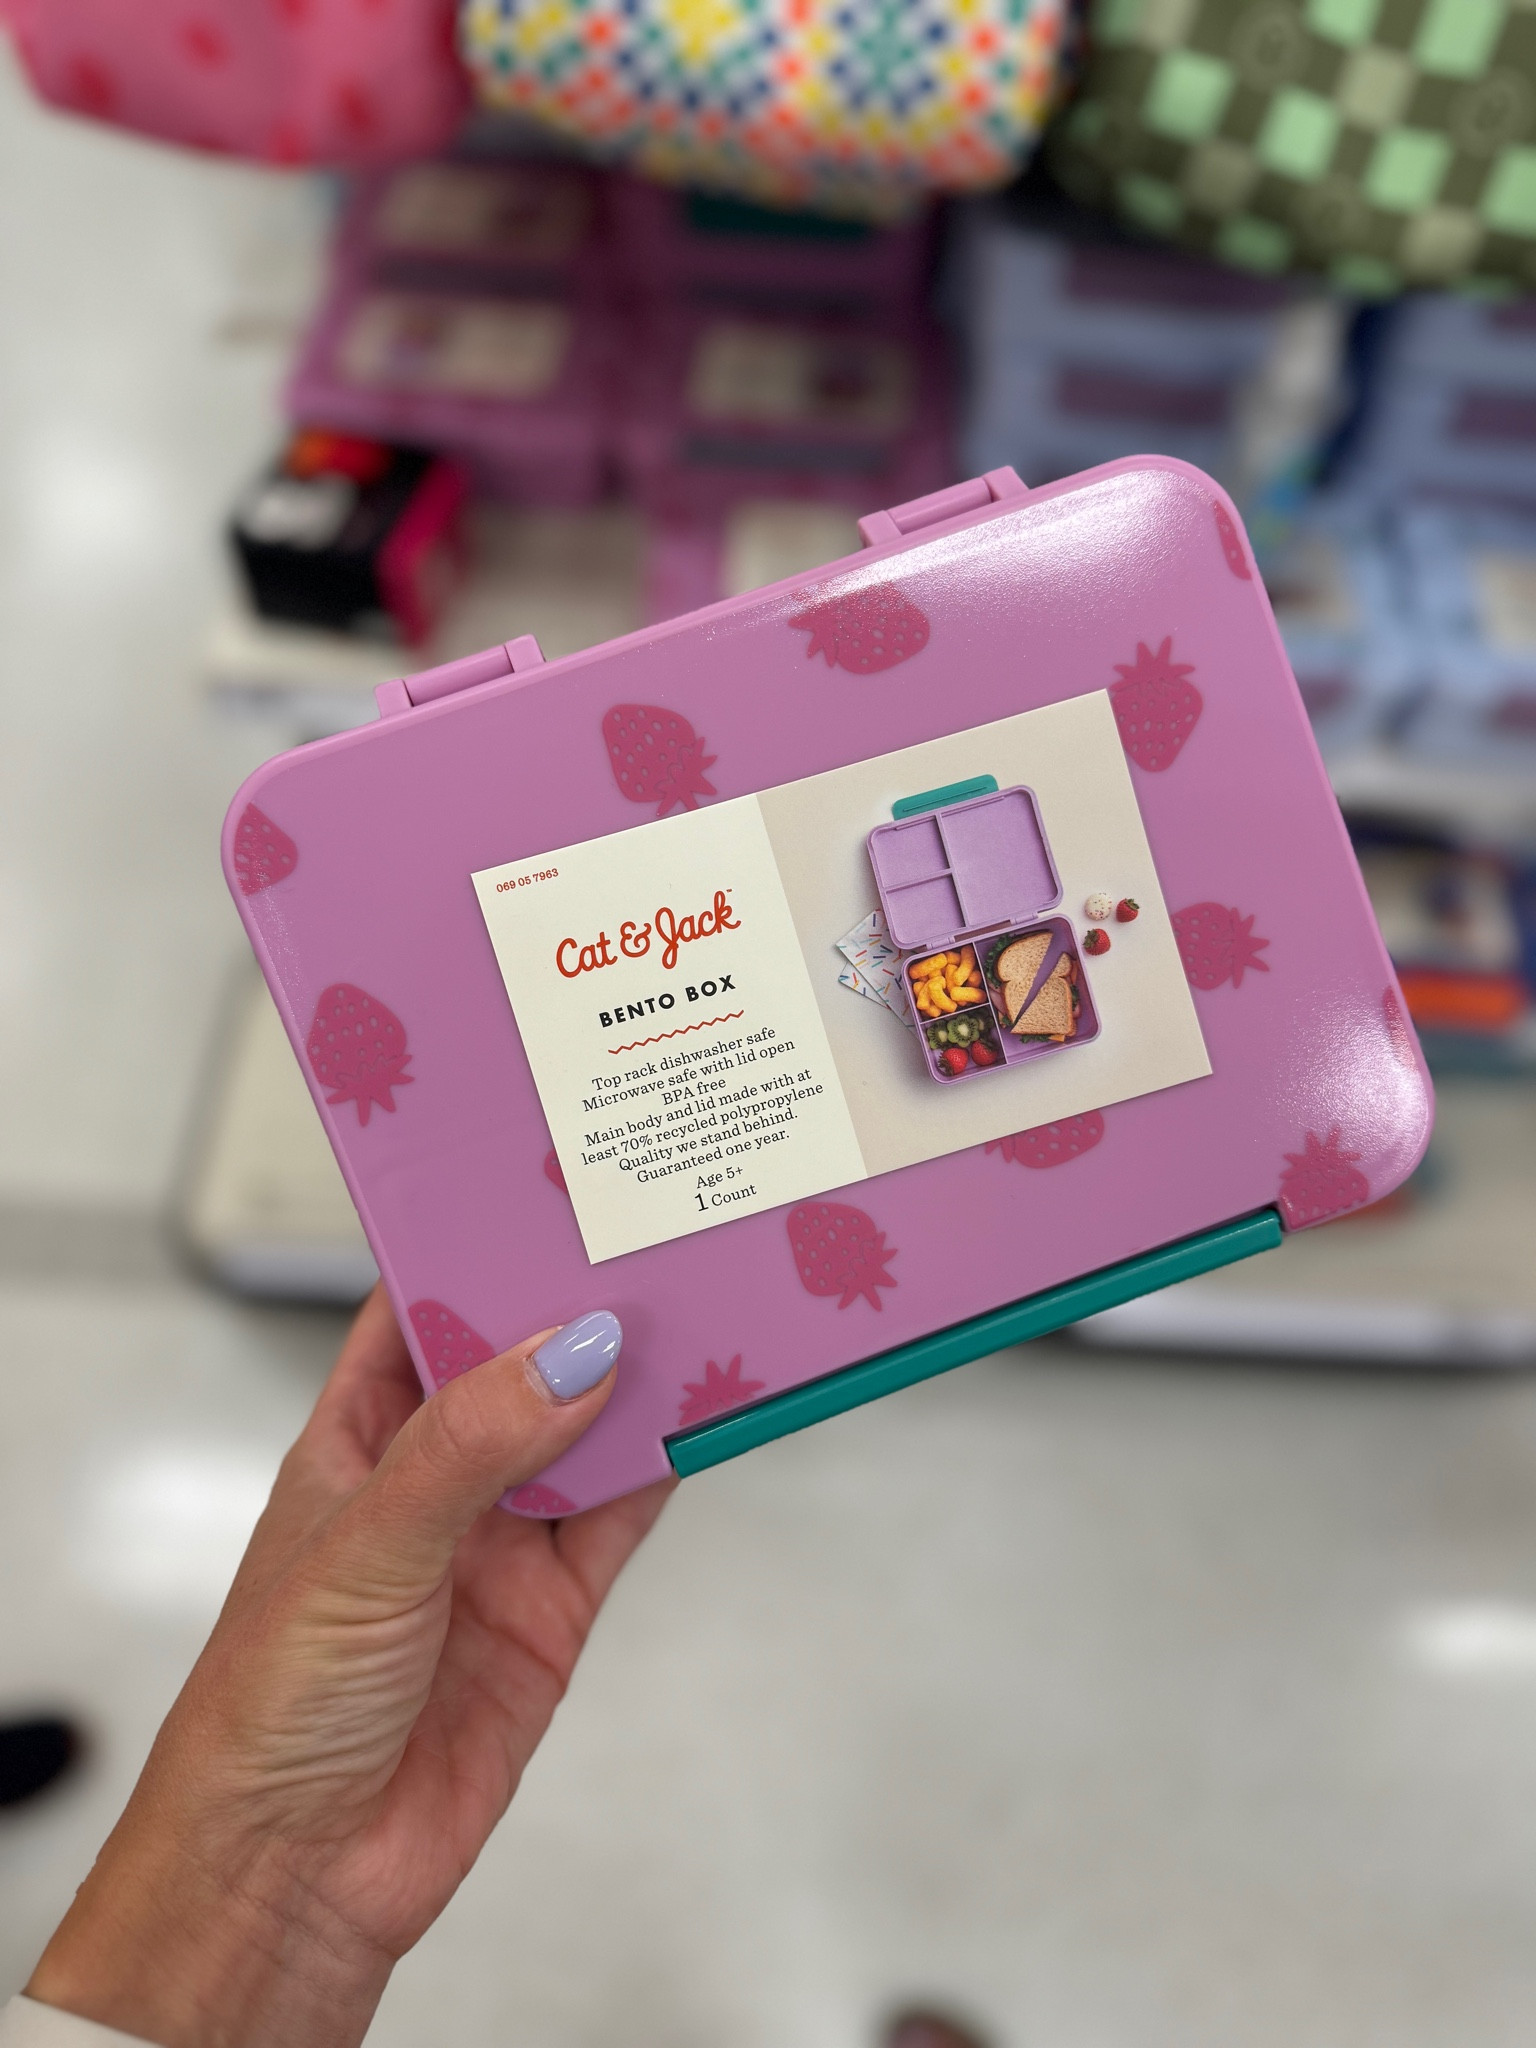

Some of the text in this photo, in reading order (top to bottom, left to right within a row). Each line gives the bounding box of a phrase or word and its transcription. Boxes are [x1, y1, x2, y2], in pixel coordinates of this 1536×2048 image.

[496, 868, 559, 893] 069 05 7963
[555, 931, 618, 978] Cat
[619, 921, 652, 958] &
[598, 974, 736, 1028] BENTO BOX
[582, 1041, 795, 1112] Microwave safe with lid open
[591, 1027, 775, 1091] Top rack dishwasher safe
[584, 1069, 812, 1147] Main body and lid made with at
[661, 1079, 726, 1105] BPA free
[581, 1084, 823, 1165] least 70% recycled polypropylene
[619, 1107, 798, 1171] Quality we stand behind.
[637, 1130, 789, 1183] Guaranteed one year.
[696, 1166, 743, 1189] Age 5+
[694, 1184, 757, 1212] 1 Count
